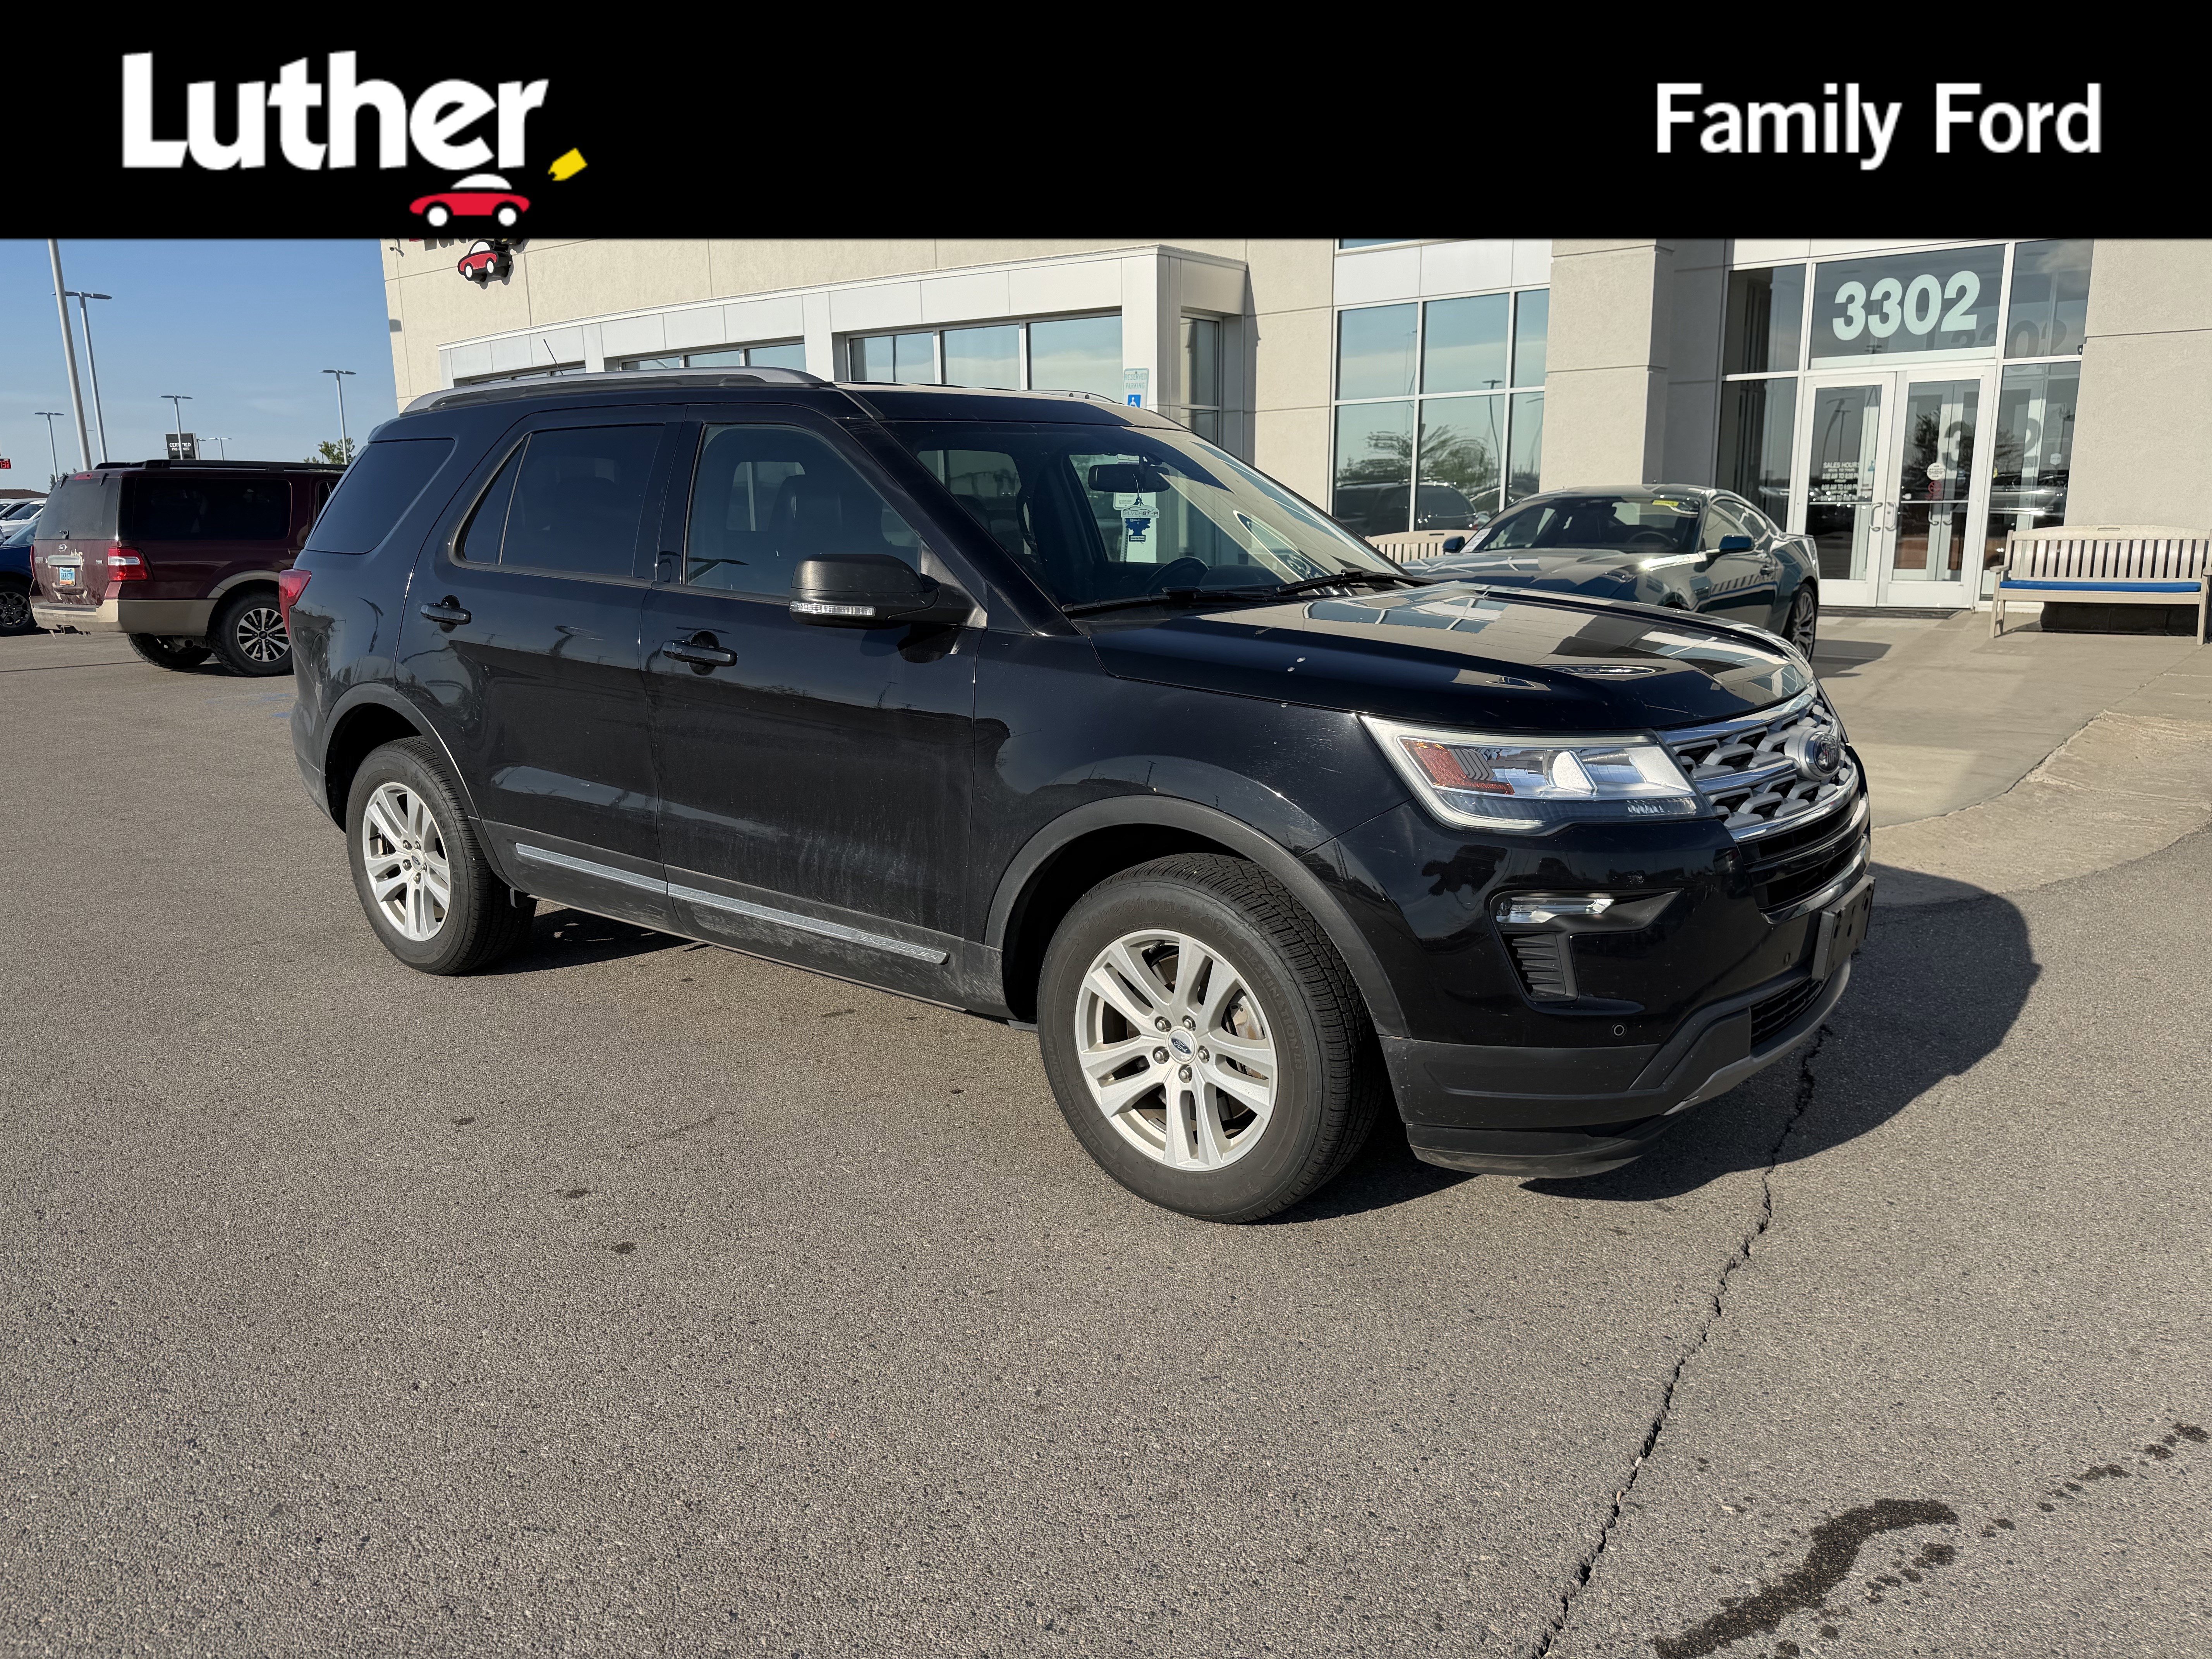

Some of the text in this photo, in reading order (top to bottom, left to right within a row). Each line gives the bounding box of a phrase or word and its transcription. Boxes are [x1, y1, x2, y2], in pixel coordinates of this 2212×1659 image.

[1832, 270, 1980, 341] 3302
[1079, 896, 1192, 936] Firestone
[857, 935, 938, 960] EXPLORER
[1241, 945, 1299, 1049] DESTINATION
[1174, 1040, 1188, 1053] Ford
